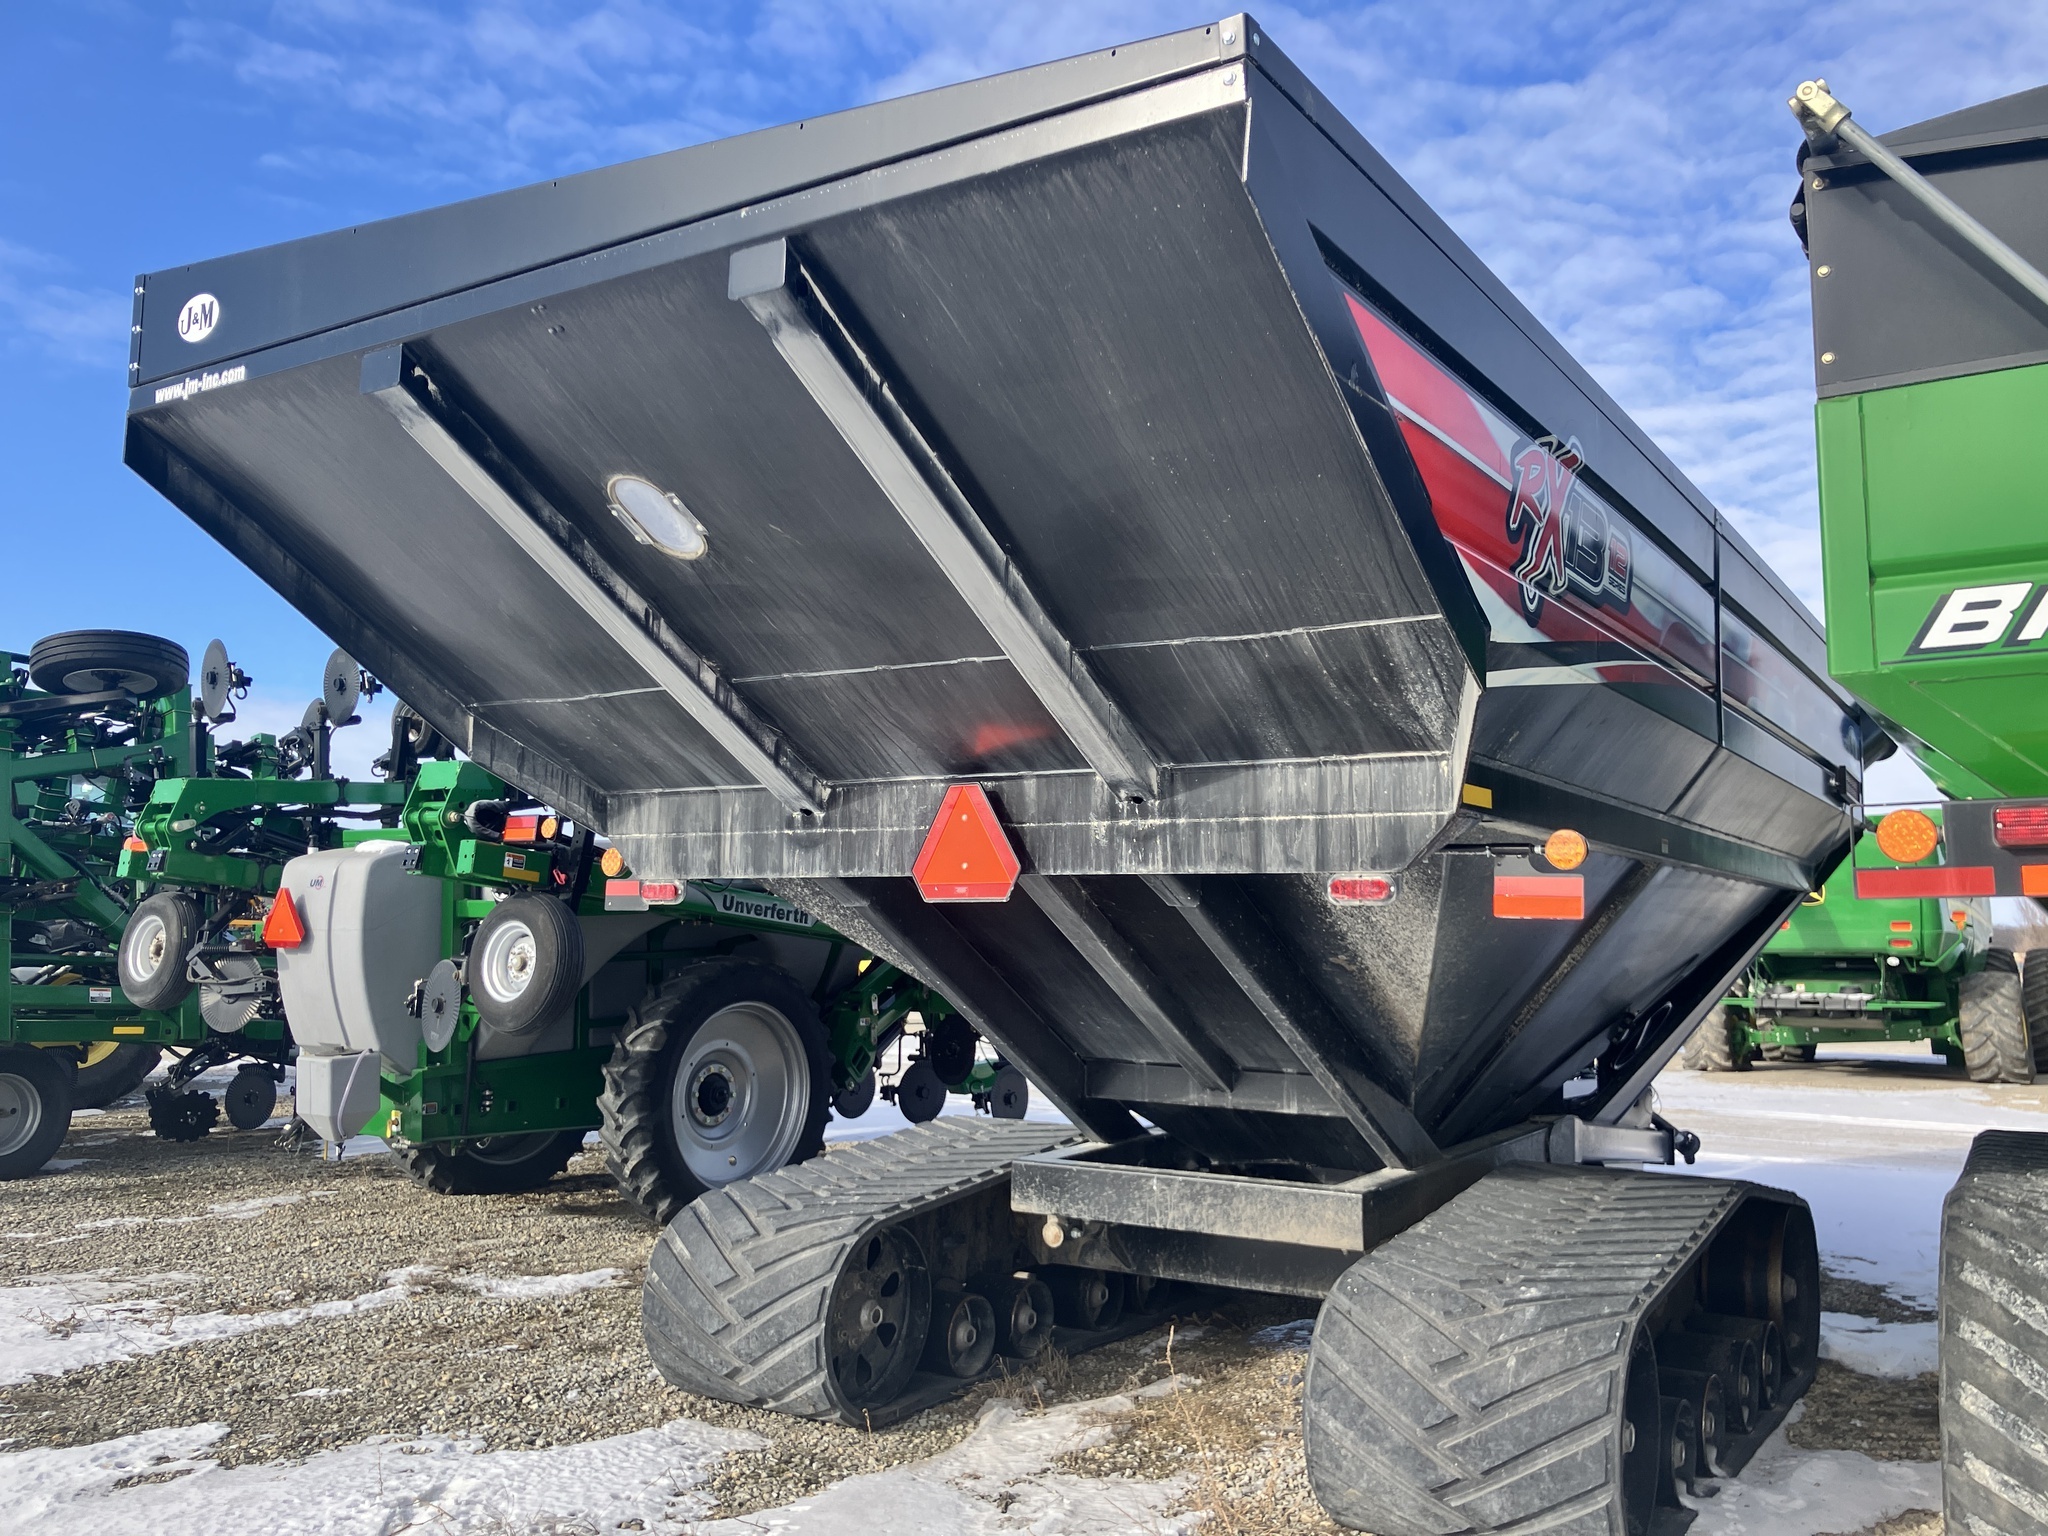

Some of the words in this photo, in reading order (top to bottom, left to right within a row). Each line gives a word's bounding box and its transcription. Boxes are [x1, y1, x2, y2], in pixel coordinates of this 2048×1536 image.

[180, 300, 215, 335] J&M
[155, 364, 246, 404] www.jm-inc.com
[1609, 537, 1628, 580] 12
[310, 877, 323, 889] UM
[722, 894, 810, 925] Unverferth
